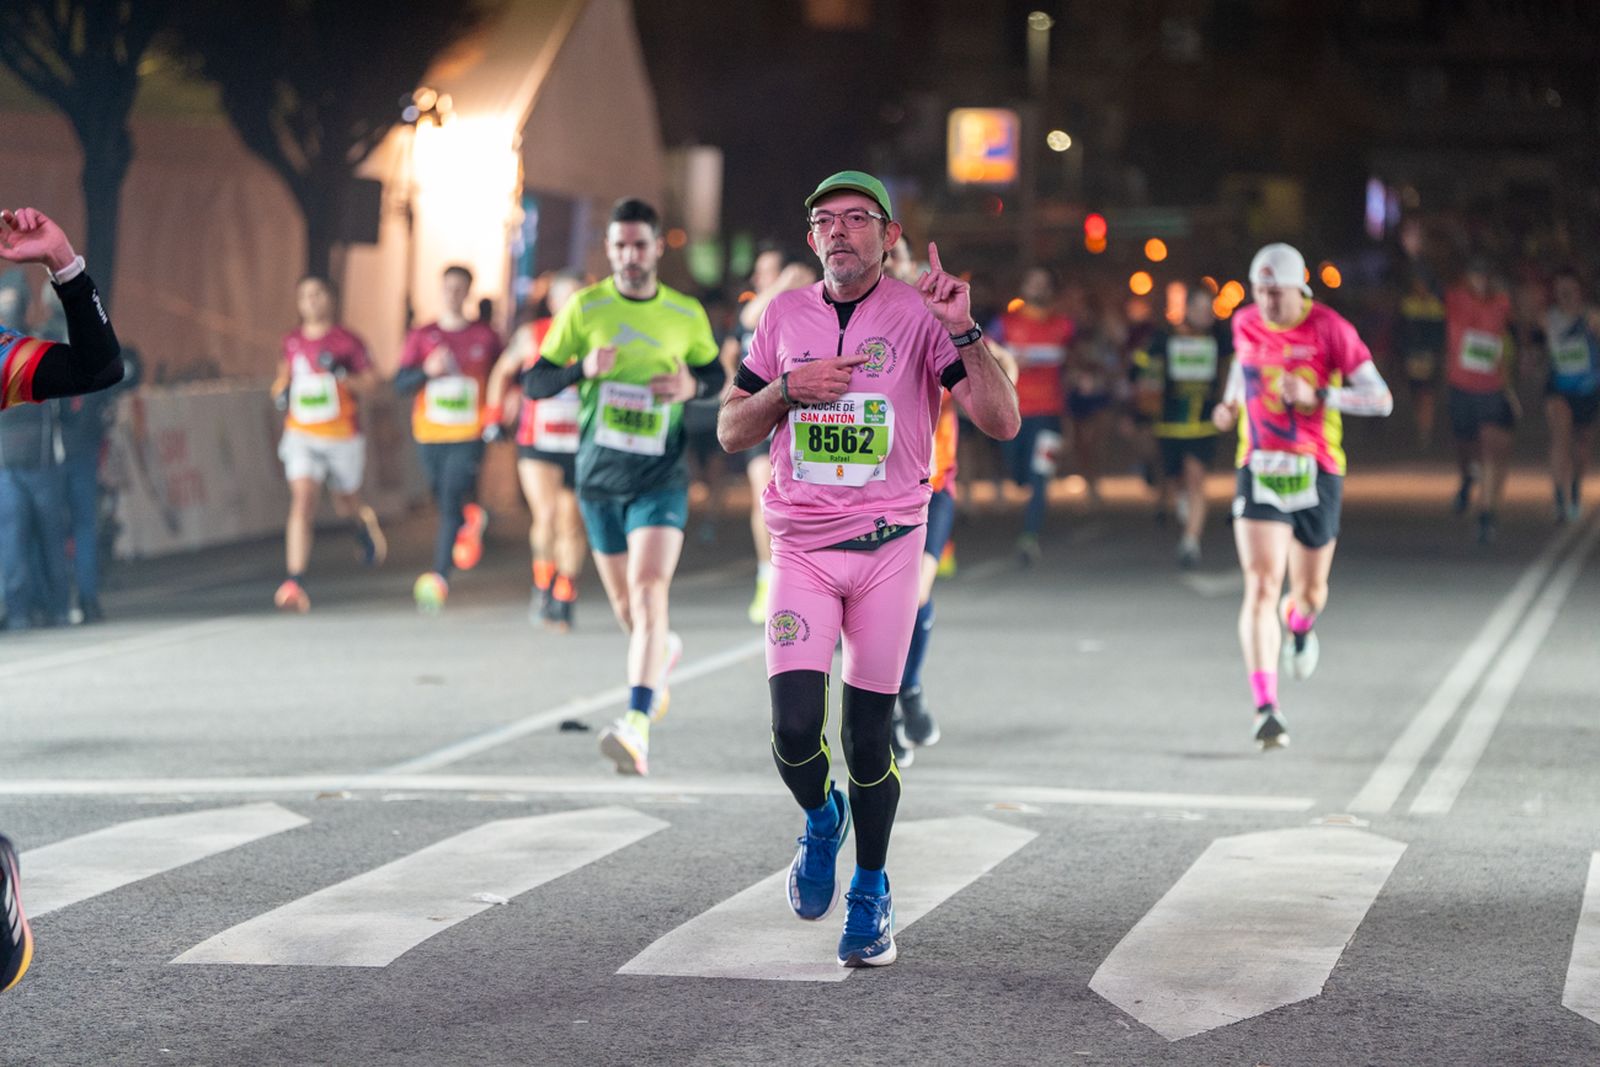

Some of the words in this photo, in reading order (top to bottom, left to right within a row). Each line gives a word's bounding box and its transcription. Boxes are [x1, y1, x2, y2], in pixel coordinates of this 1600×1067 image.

[843, 403, 855, 412] DE
[800, 412, 819, 422] SAN
[821, 412, 855, 424] ANTÓN
[809, 424, 875, 454] 8562
